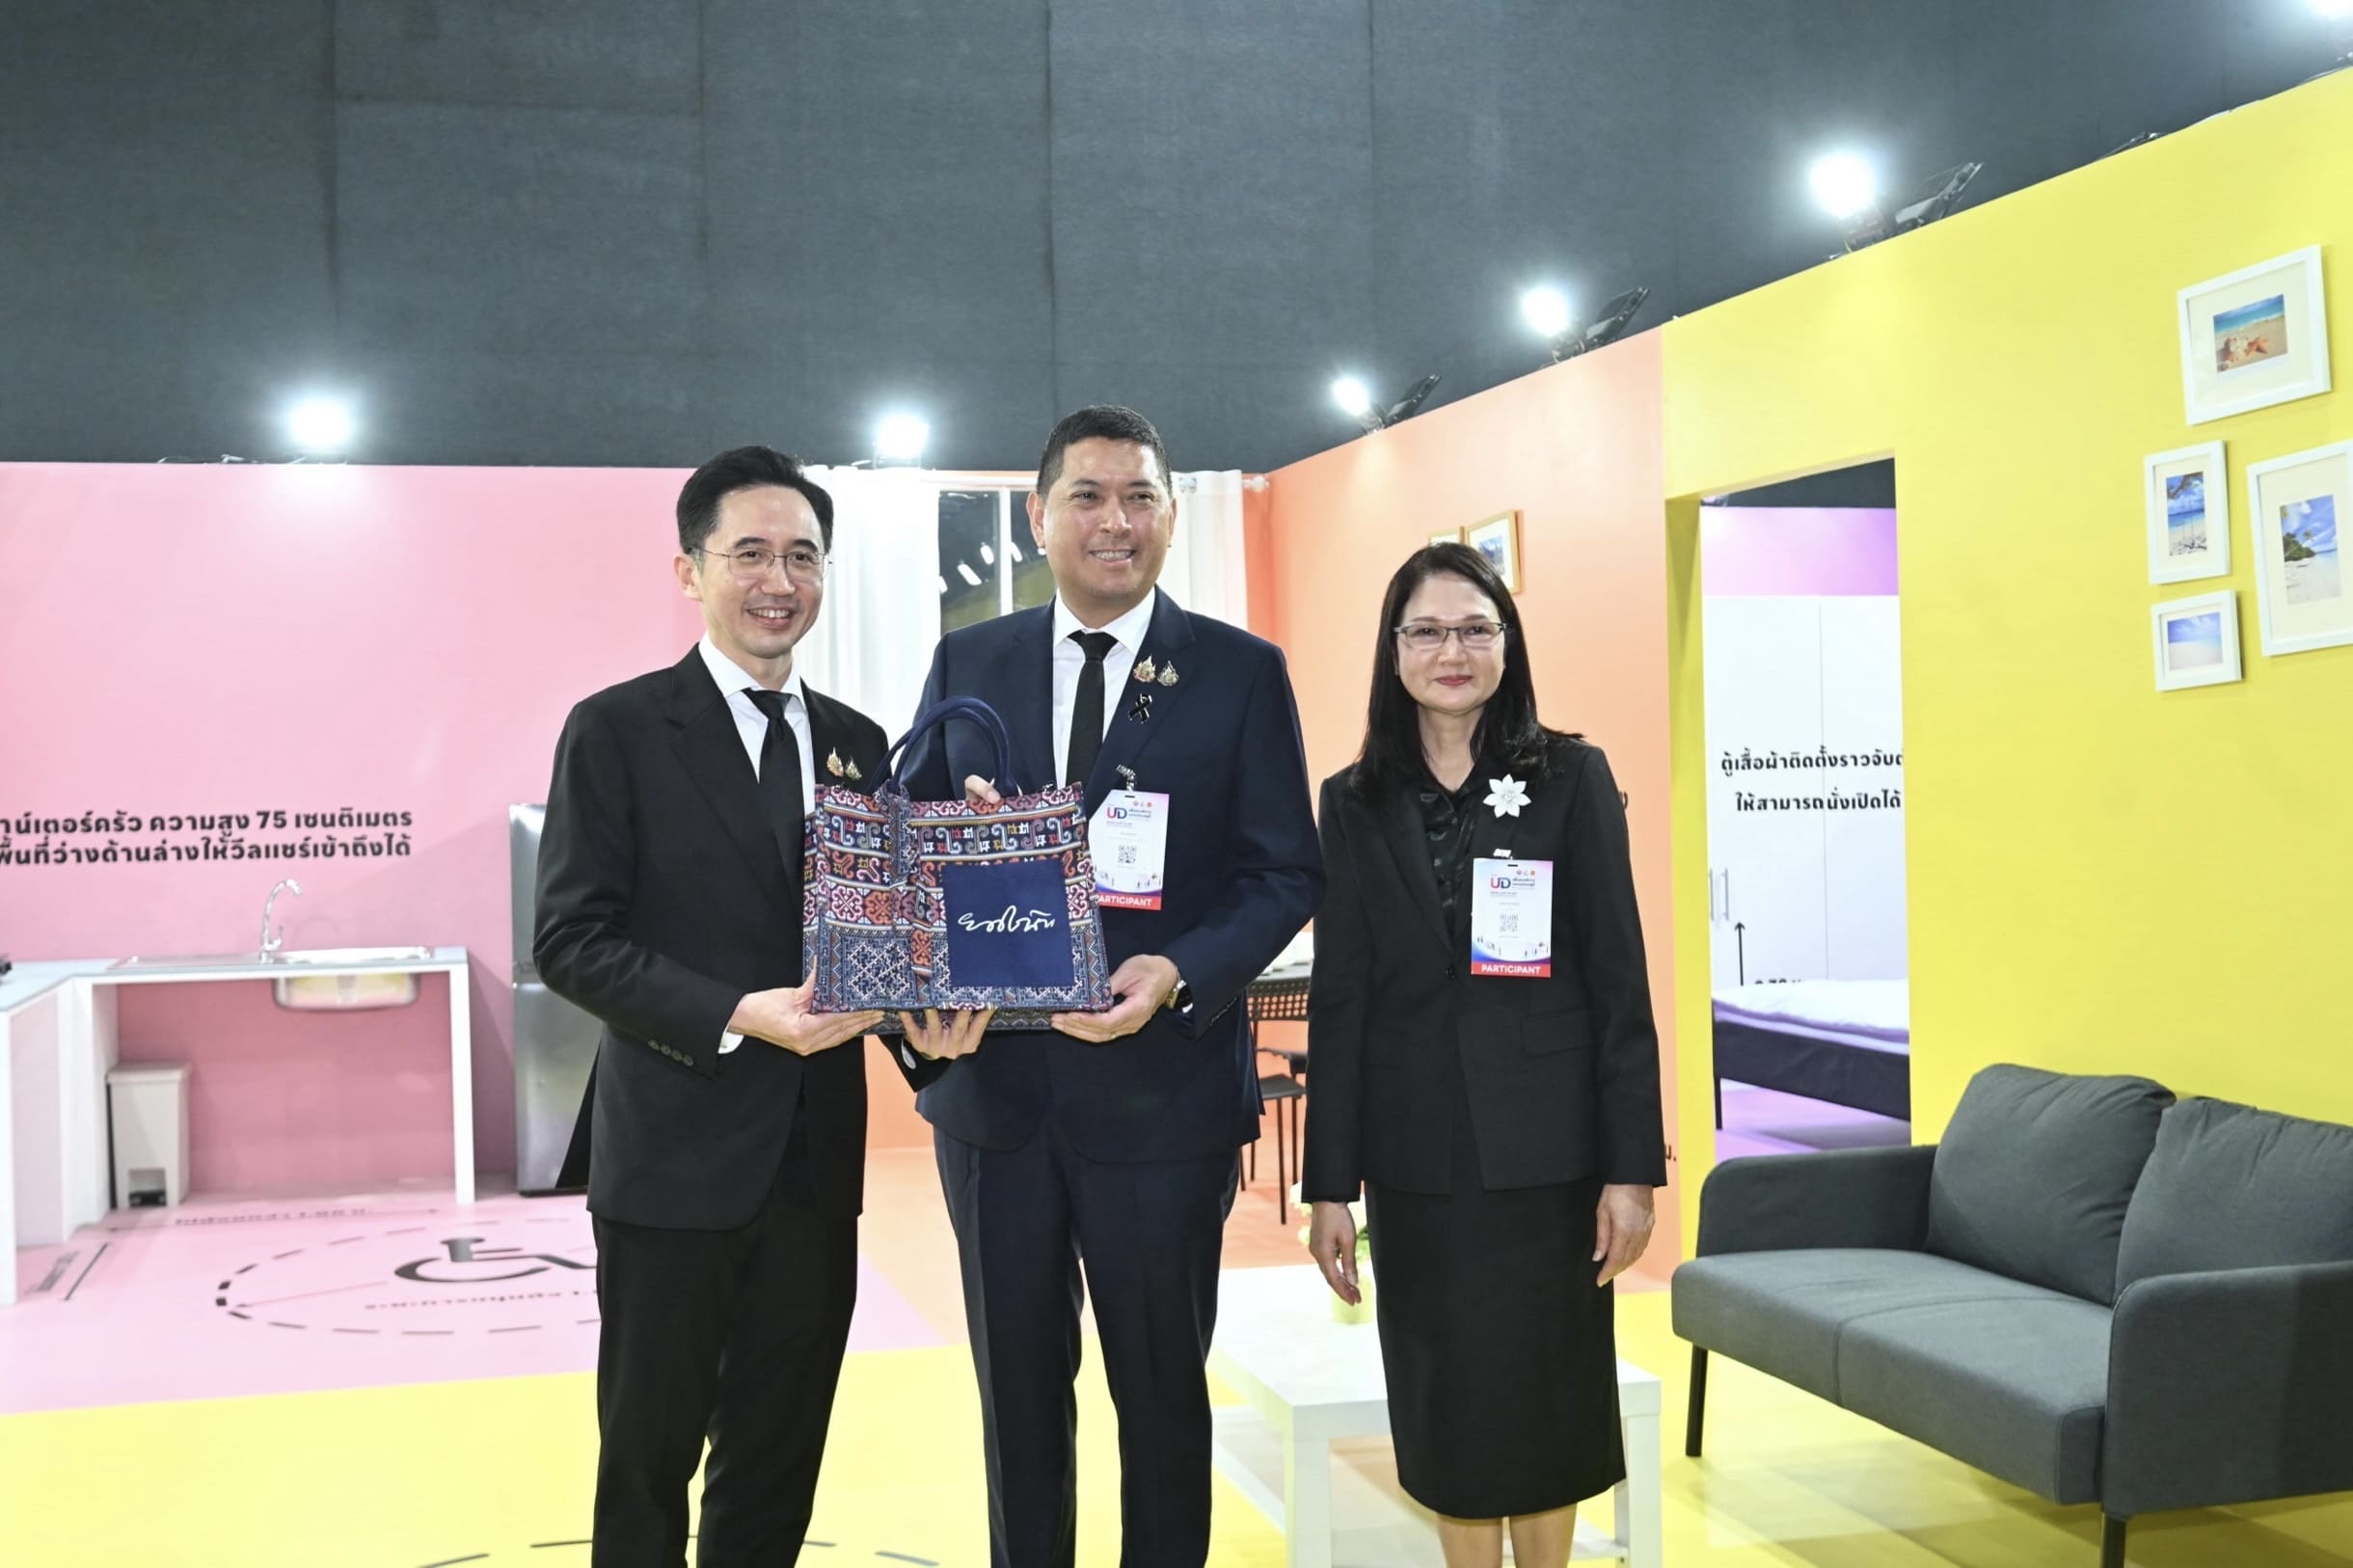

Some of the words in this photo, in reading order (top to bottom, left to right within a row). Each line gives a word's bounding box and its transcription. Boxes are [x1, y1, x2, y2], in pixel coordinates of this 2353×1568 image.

[149, 814, 251, 837] ความสูง
[257, 810, 287, 829] 75
[294, 807, 413, 828] เซนติเมตร
[1481, 963, 1541, 974] PARTICIPANT
